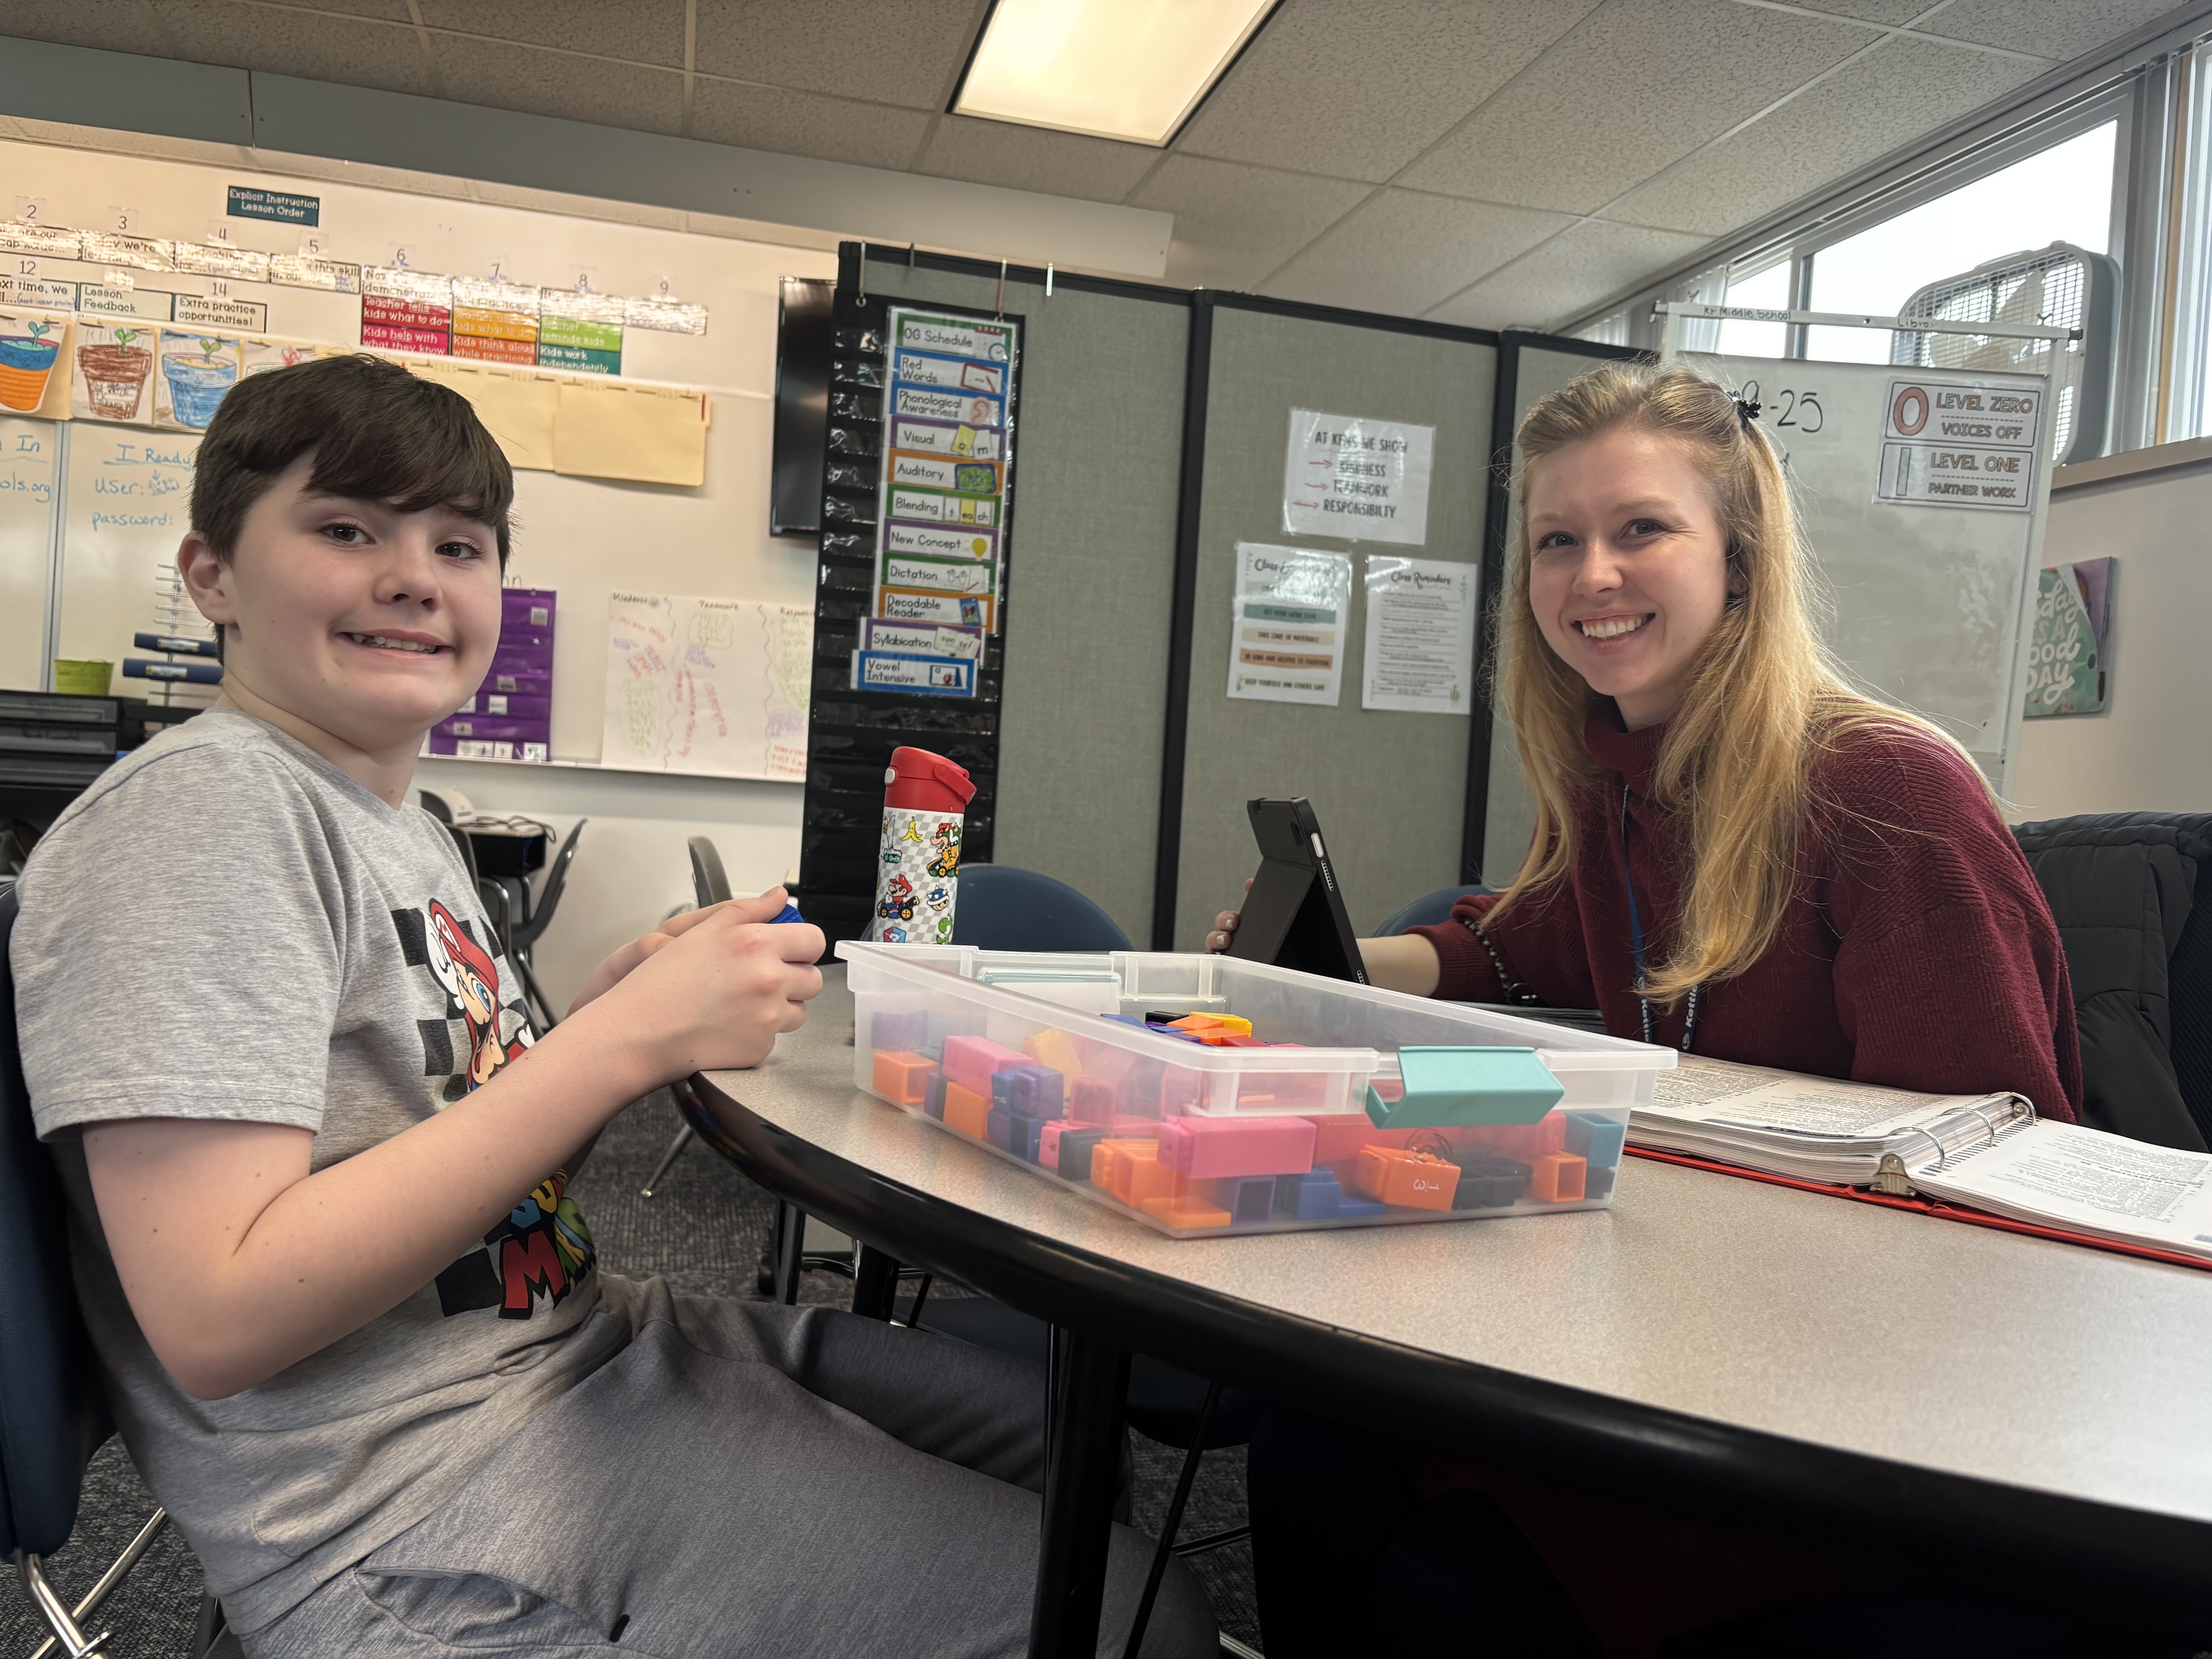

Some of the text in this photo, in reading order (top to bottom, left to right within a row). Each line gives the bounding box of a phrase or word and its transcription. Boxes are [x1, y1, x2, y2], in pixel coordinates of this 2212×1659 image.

[229, 188, 318, 210] Explicit Instruction
[27, 204, 36, 219] 2
[241, 201, 305, 218] Lesson Order
[118, 215, 127, 229] 3
[309, 239, 319, 254] 5
[397, 248, 406, 262] 6
[19, 260, 36, 275] 12
[491, 263, 500, 278] 7
[85, 286, 122, 299] Lesson
[213, 282, 227, 296] 14
[84, 298, 136, 313] Feedback
[180, 297, 256, 315] Extra practice
[364, 295, 406, 309] Teacher
[179, 311, 252, 326] opportunities!
[364, 307, 386, 319] kids
[389, 311, 415, 323] what
[1720, 306, 1753, 319] Middle
[1756, 309, 1791, 320] School
[363, 326, 387, 338] Kids
[414, 333, 438, 344] with
[454, 335, 476, 347] Kids
[904, 327, 973, 347] OG Schedule
[901, 356, 922, 370] Red
[901, 369, 938, 384] Words
[898, 390, 962, 409] Phonological
[1936, 392, 2033, 414] LEVEL ZERO
[900, 400, 960, 419] Awareness
[903, 429, 935, 445] Visual
[1315, 431, 1328, 444] AT
[1941, 422, 2023, 440] VOICES OFF
[16, 434, 40, 453] In
[1930, 451, 2020, 473] LEVEL ONE
[896, 463, 944, 480] Auditory
[1928, 482, 2016, 499] PARTNER WORK
[895, 497, 939, 514] Blending
[891, 532, 962, 550] New Concept
[890, 565, 938, 581] Dictation
[887, 594, 941, 610] Decodable
[887, 606, 924, 619] Reader
[873, 633, 932, 648] Syllabication
[2029, 622, 2081, 666] ood
[867, 659, 900, 672] Vowel
[866, 670, 916, 684] Intensive
